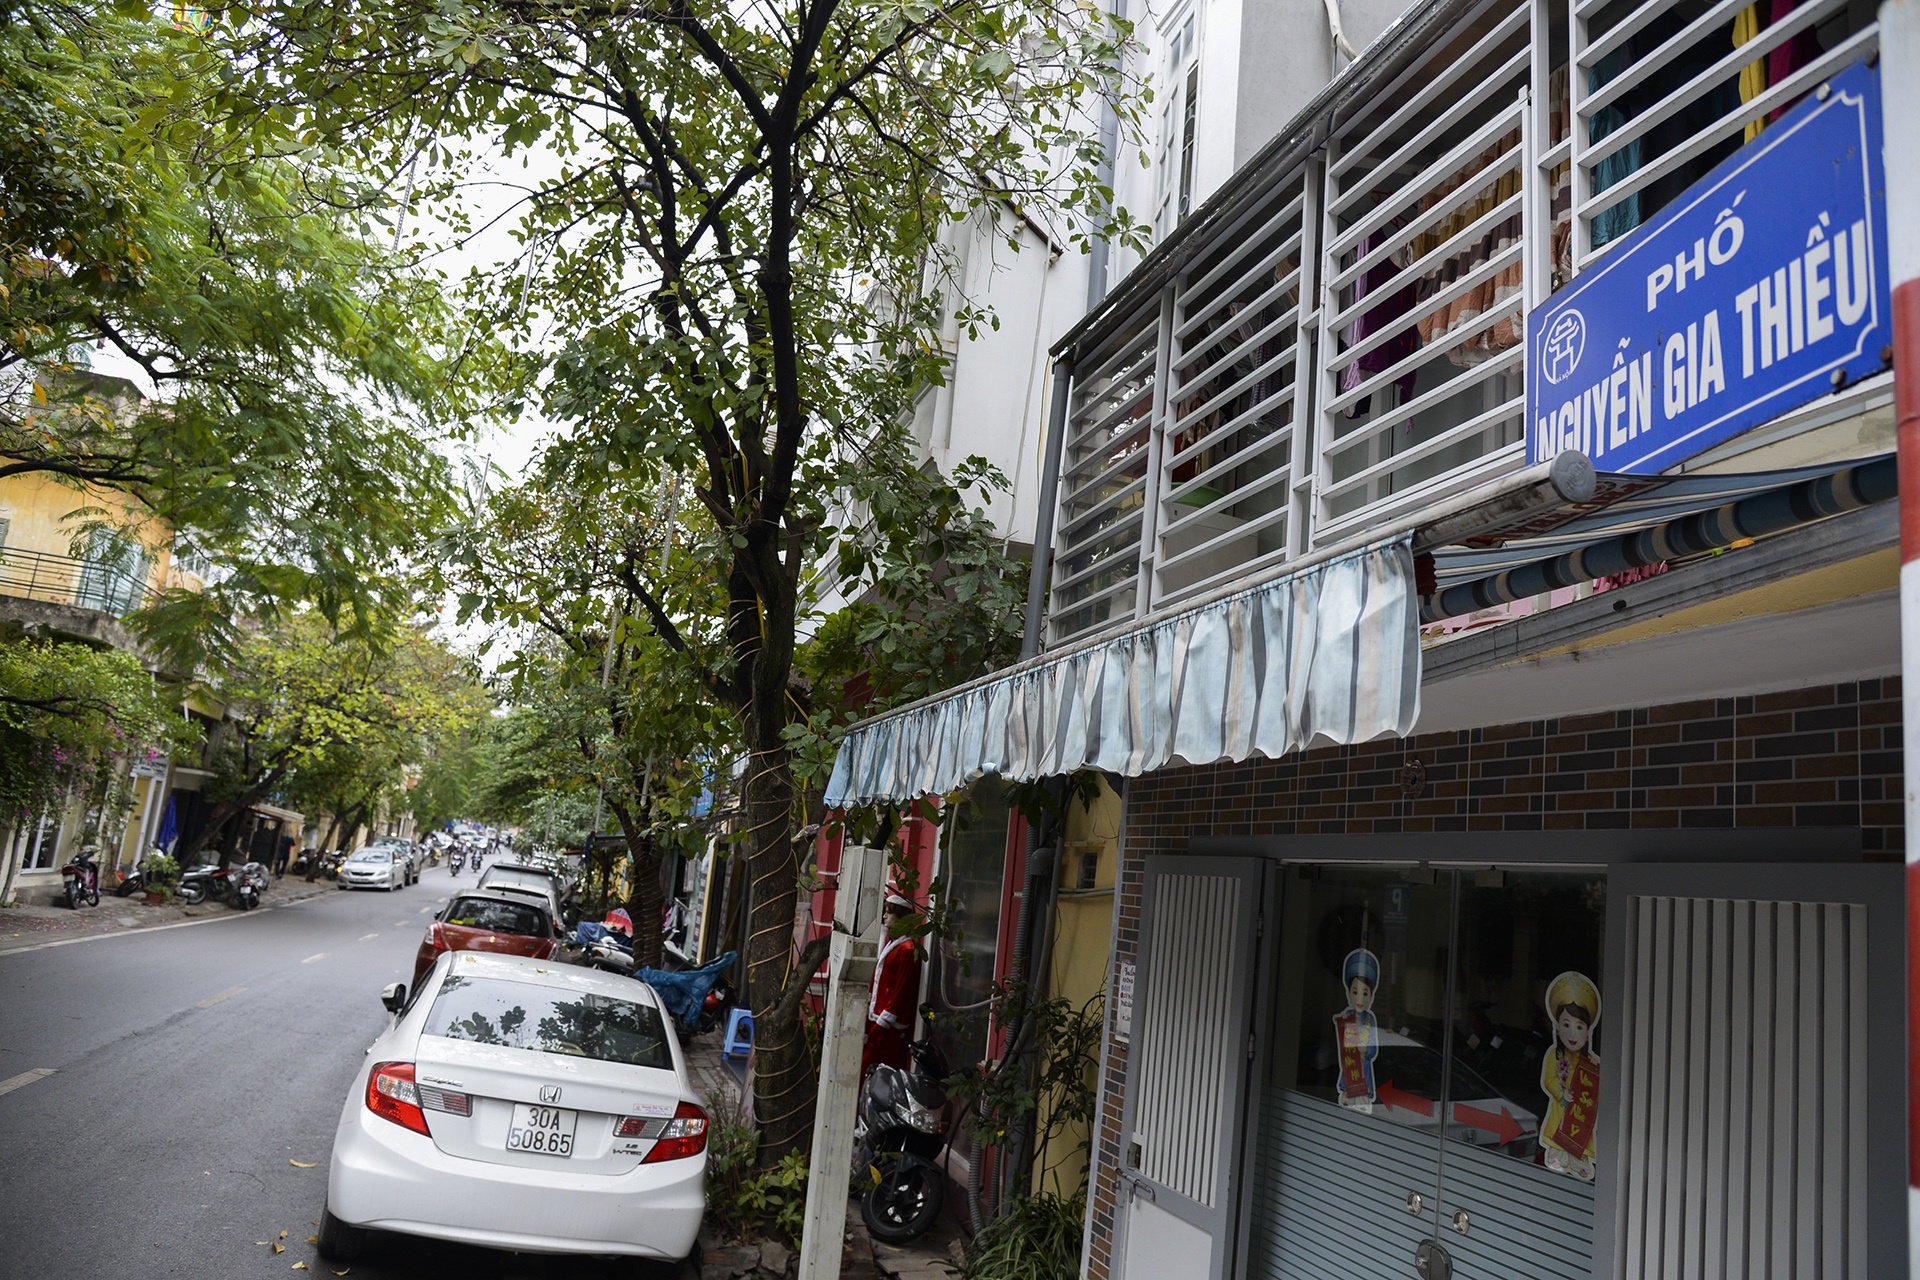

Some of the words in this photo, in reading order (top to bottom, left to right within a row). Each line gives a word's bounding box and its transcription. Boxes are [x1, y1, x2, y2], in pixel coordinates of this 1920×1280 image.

[1647, 189, 1747, 313] PHỐ
[1538, 337, 1652, 462] NGUYỄN
[1663, 309, 1726, 420] GIA
[1735, 210, 1869, 380] THIỀU
[510, 1127, 572, 1154] 508.65
[527, 1107, 560, 1131] 30A
